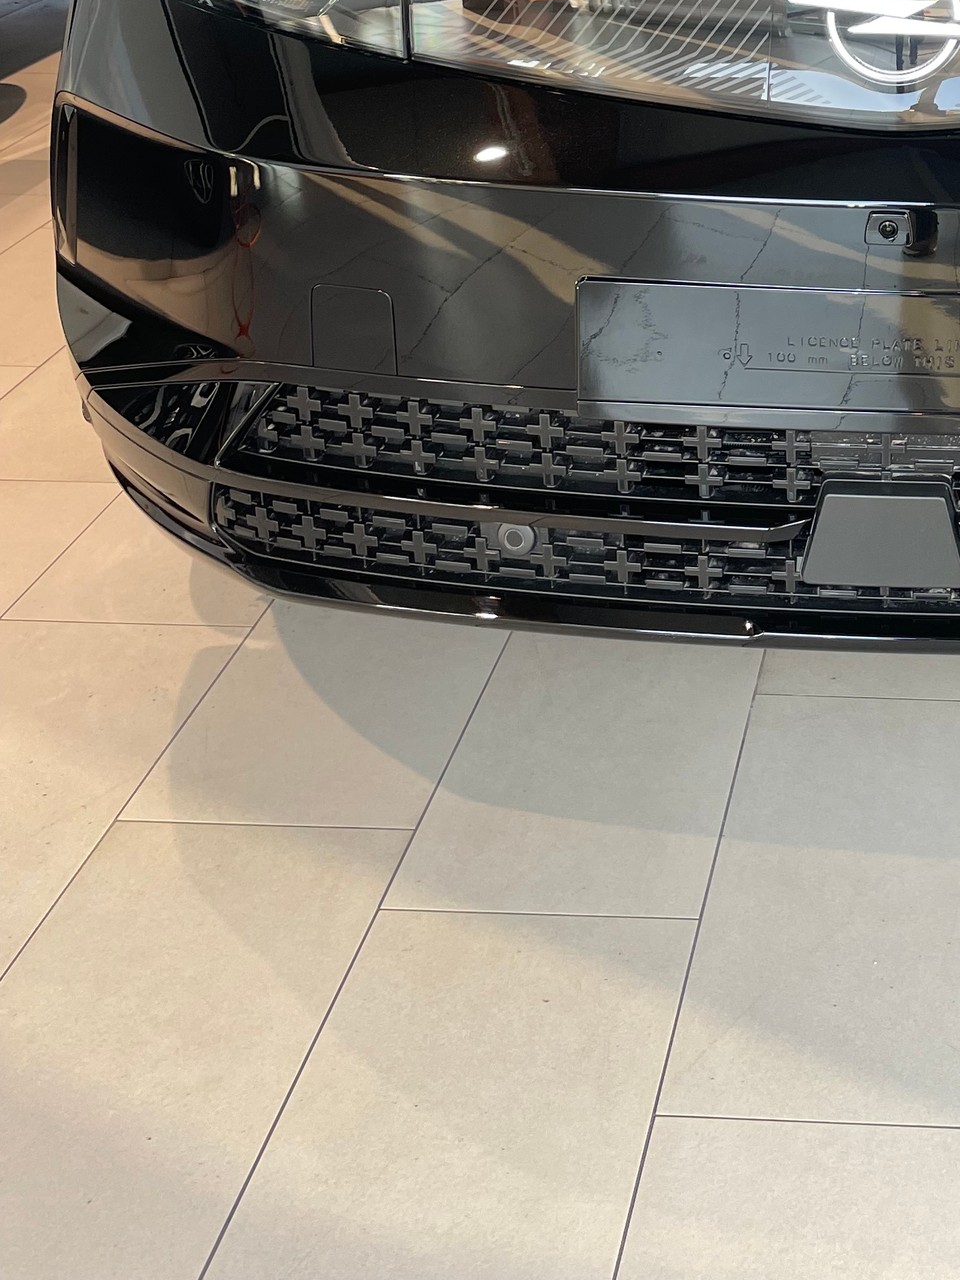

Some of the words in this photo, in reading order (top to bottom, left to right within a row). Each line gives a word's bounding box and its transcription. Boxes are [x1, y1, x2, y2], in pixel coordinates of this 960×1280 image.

[787, 336, 859, 349] LICENCE
[871, 337, 923, 352] PLATE
[767, 351, 796, 363] 100
[807, 354, 828, 365] mm
[850, 353, 903, 367] BELOW
[913, 355, 955, 369] THIS
